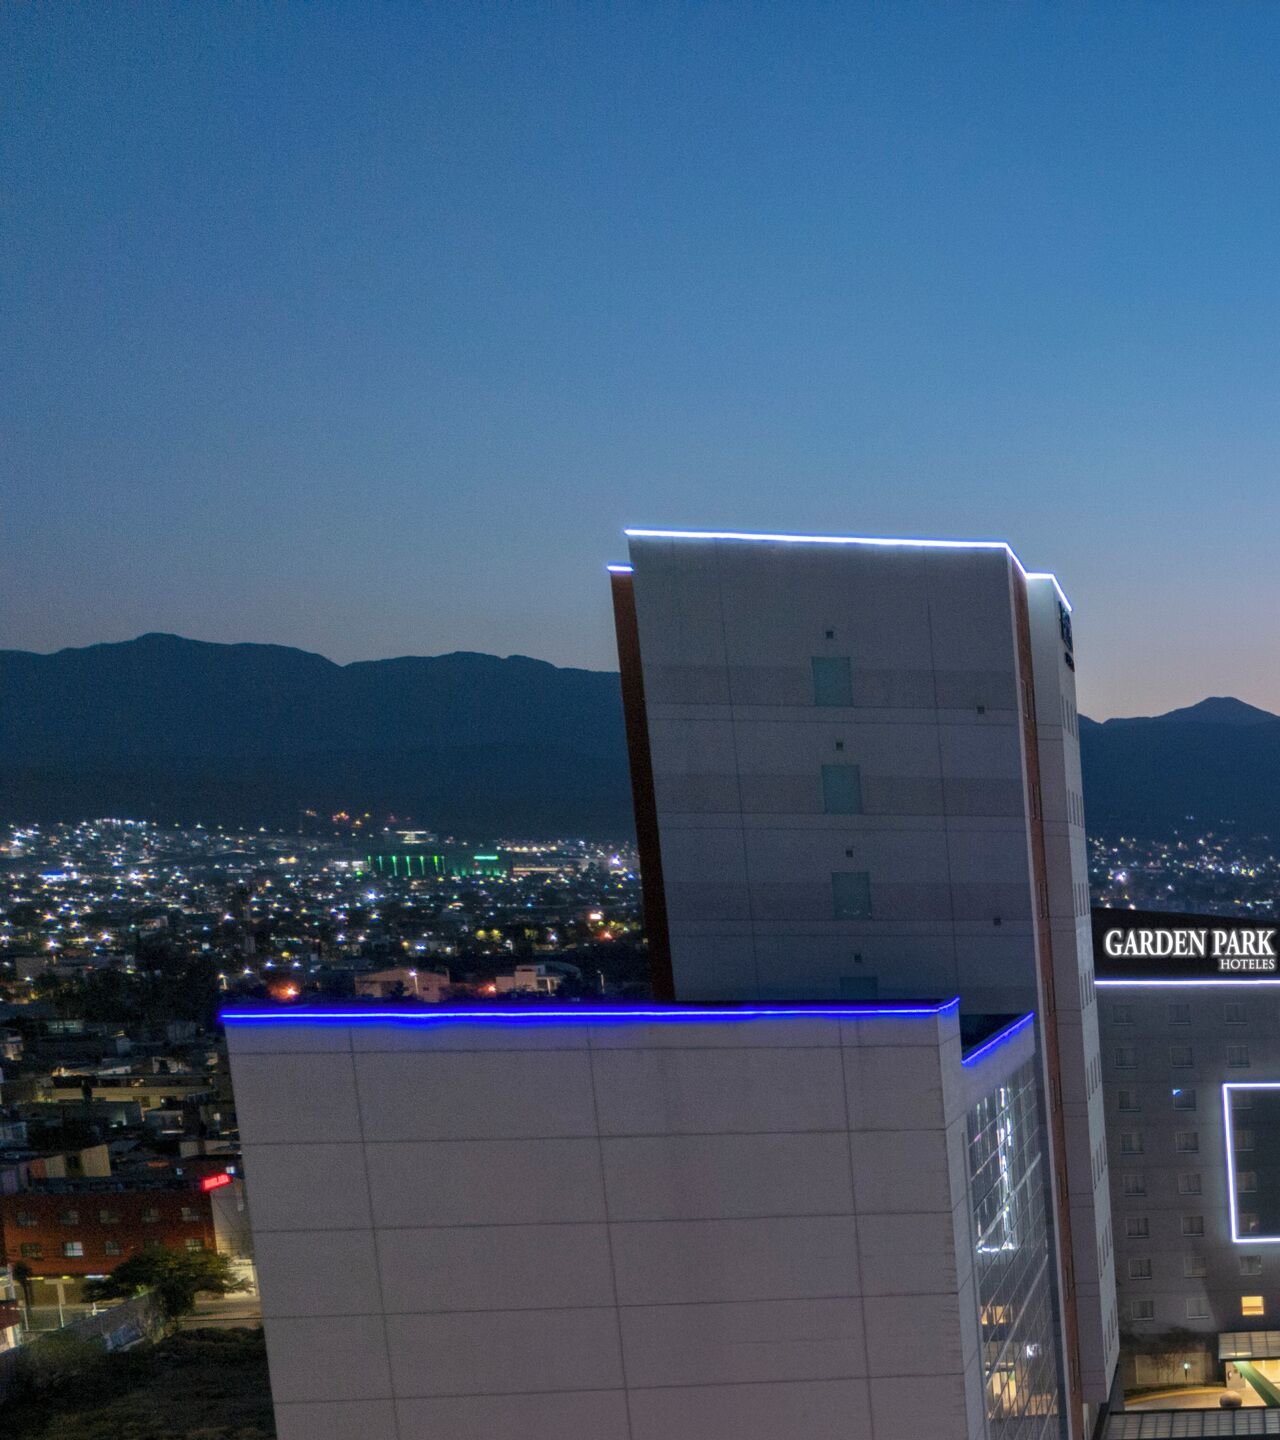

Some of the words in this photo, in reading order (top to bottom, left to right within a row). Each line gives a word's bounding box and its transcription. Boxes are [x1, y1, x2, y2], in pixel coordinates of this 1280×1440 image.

[1105, 930, 1206, 956] GARDEN
[1212, 930, 1275, 956] PARK
[1220, 959, 1275, 970] HOTELES
